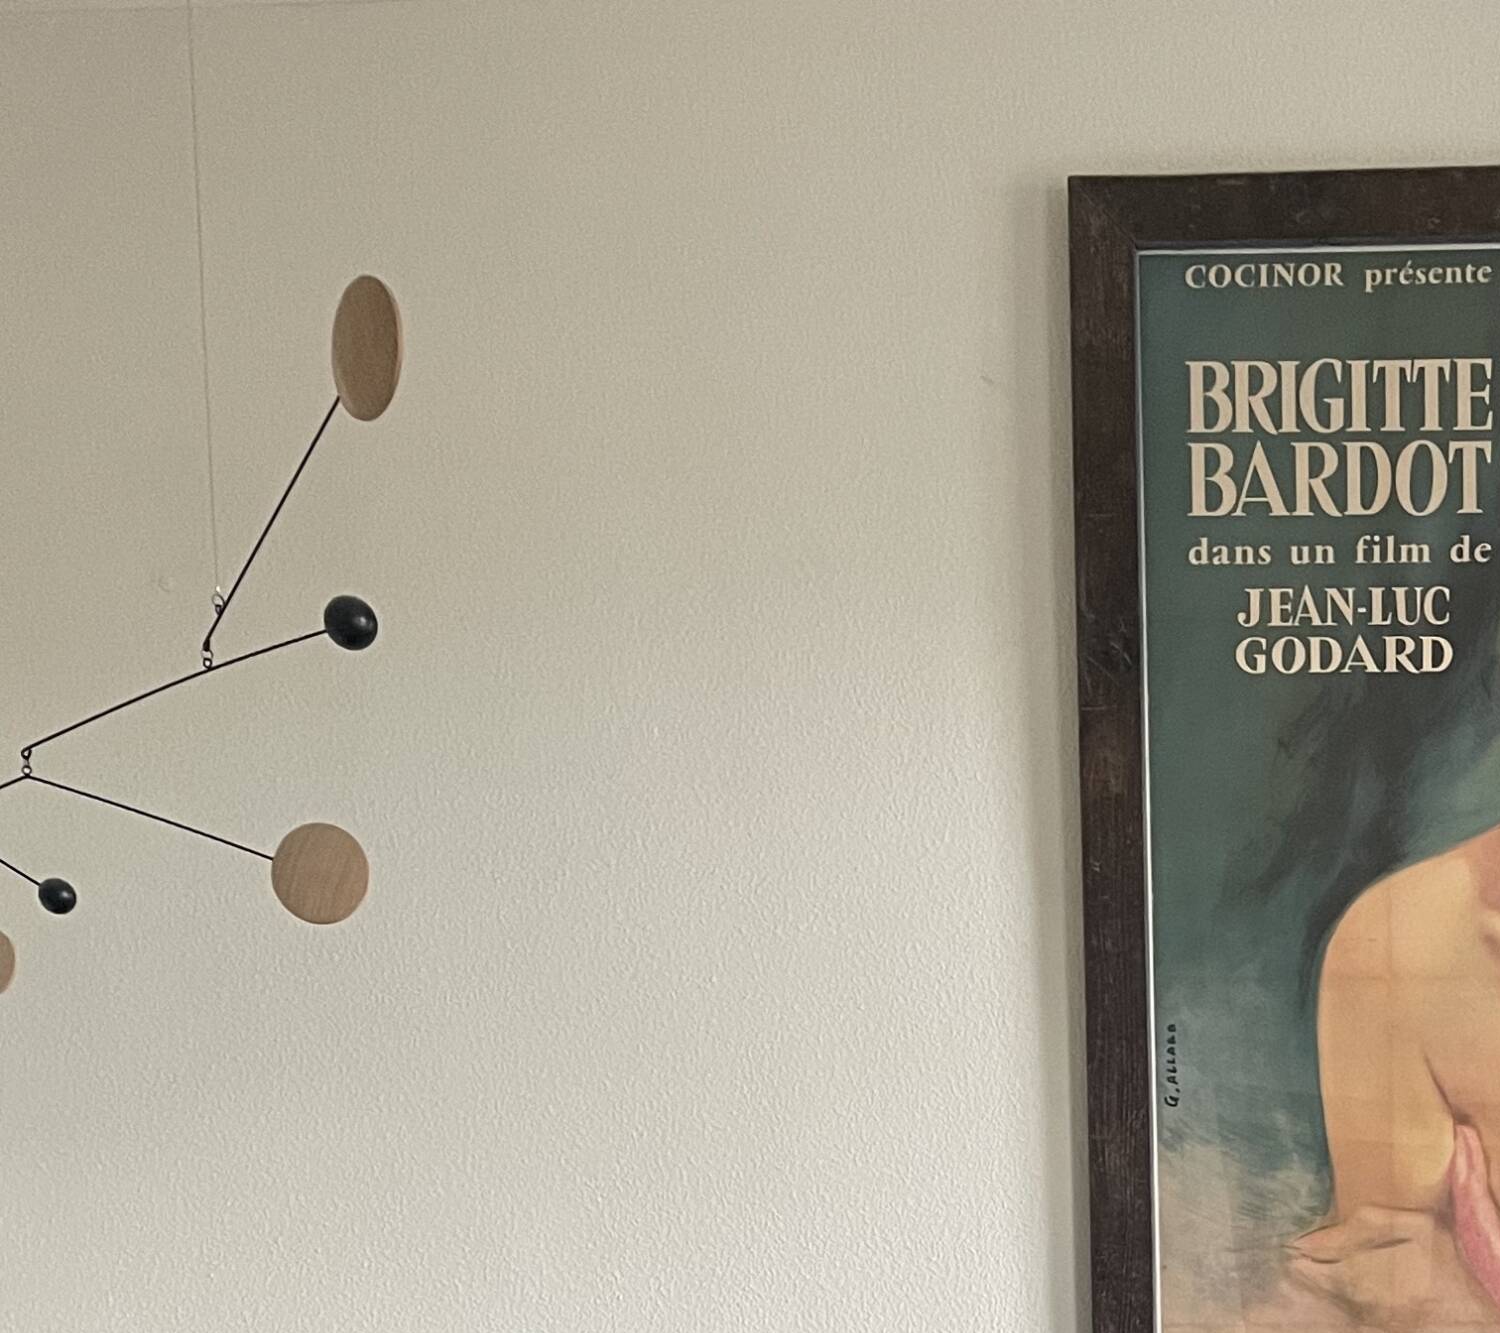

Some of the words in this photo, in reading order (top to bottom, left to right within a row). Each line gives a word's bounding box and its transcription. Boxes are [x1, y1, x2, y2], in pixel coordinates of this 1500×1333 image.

[1185, 262, 1344, 288] COCINOR
[1364, 260, 1493, 293] présente
[1185, 358, 1493, 435] BRIGITTE
[1186, 439, 1493, 517] BARDOT
[1188, 537, 1272, 566] dans
[1291, 544, 1335, 565] un
[1355, 535, 1431, 564] film
[1450, 535, 1492, 563] de
[1236, 584, 1450, 628] JEAN-LUC
[1235, 634, 1454, 674] GODARD
